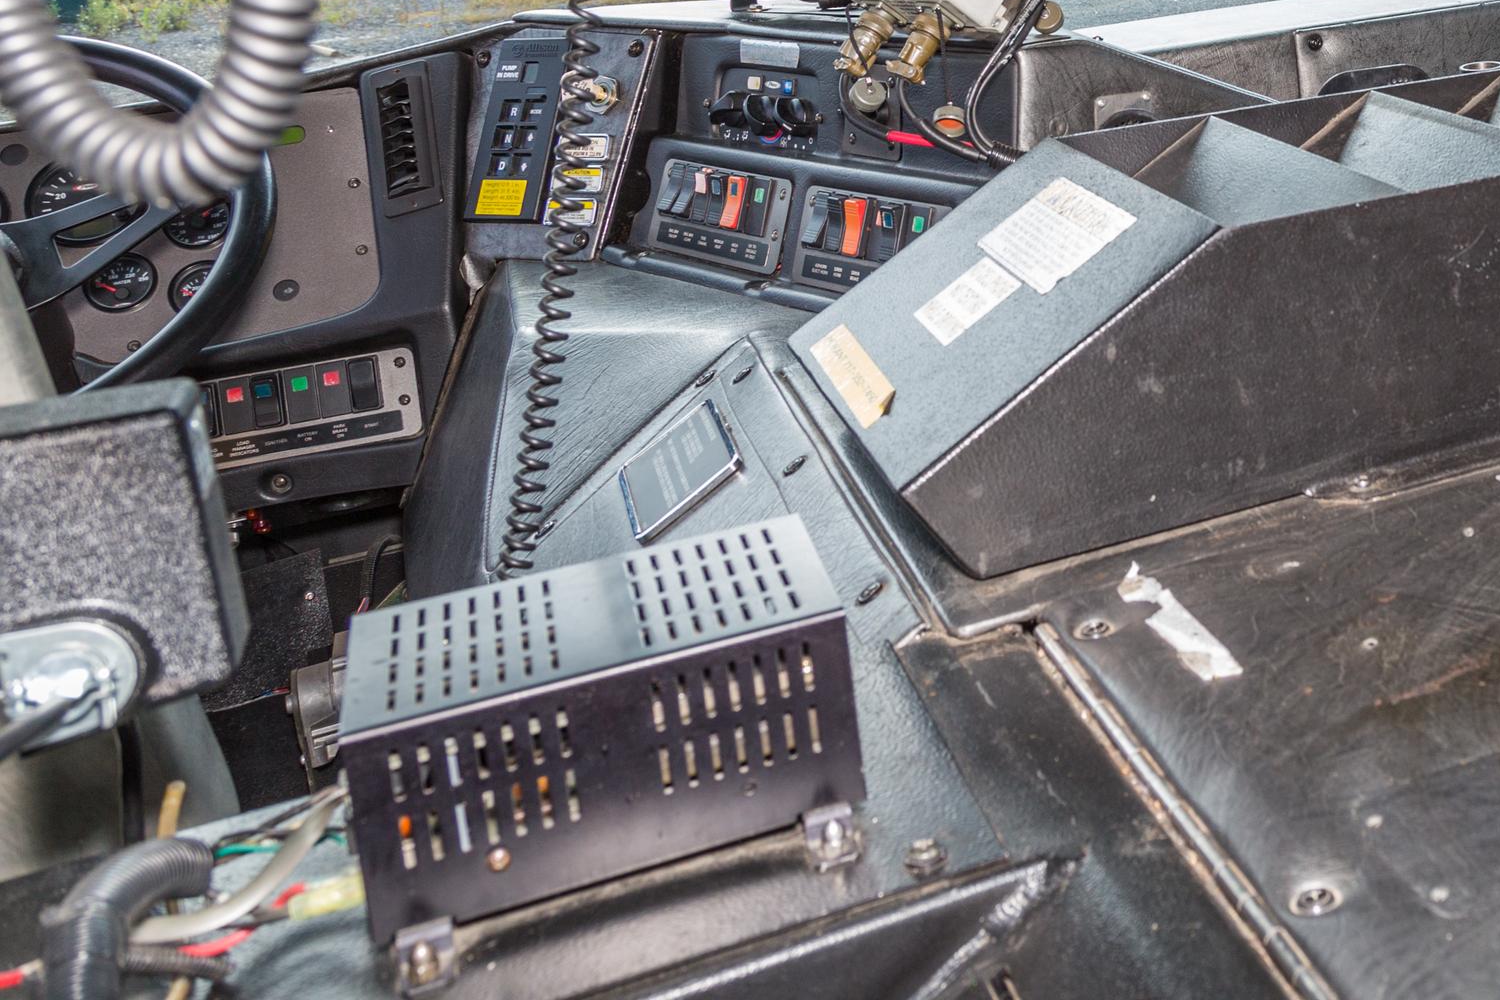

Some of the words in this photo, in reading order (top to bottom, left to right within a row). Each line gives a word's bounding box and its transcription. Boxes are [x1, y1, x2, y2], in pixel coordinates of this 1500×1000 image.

[510, 107, 517, 117] R
[504, 134, 512, 144] N
[498, 161, 505, 171] D
[54, 191, 67, 201] 20
